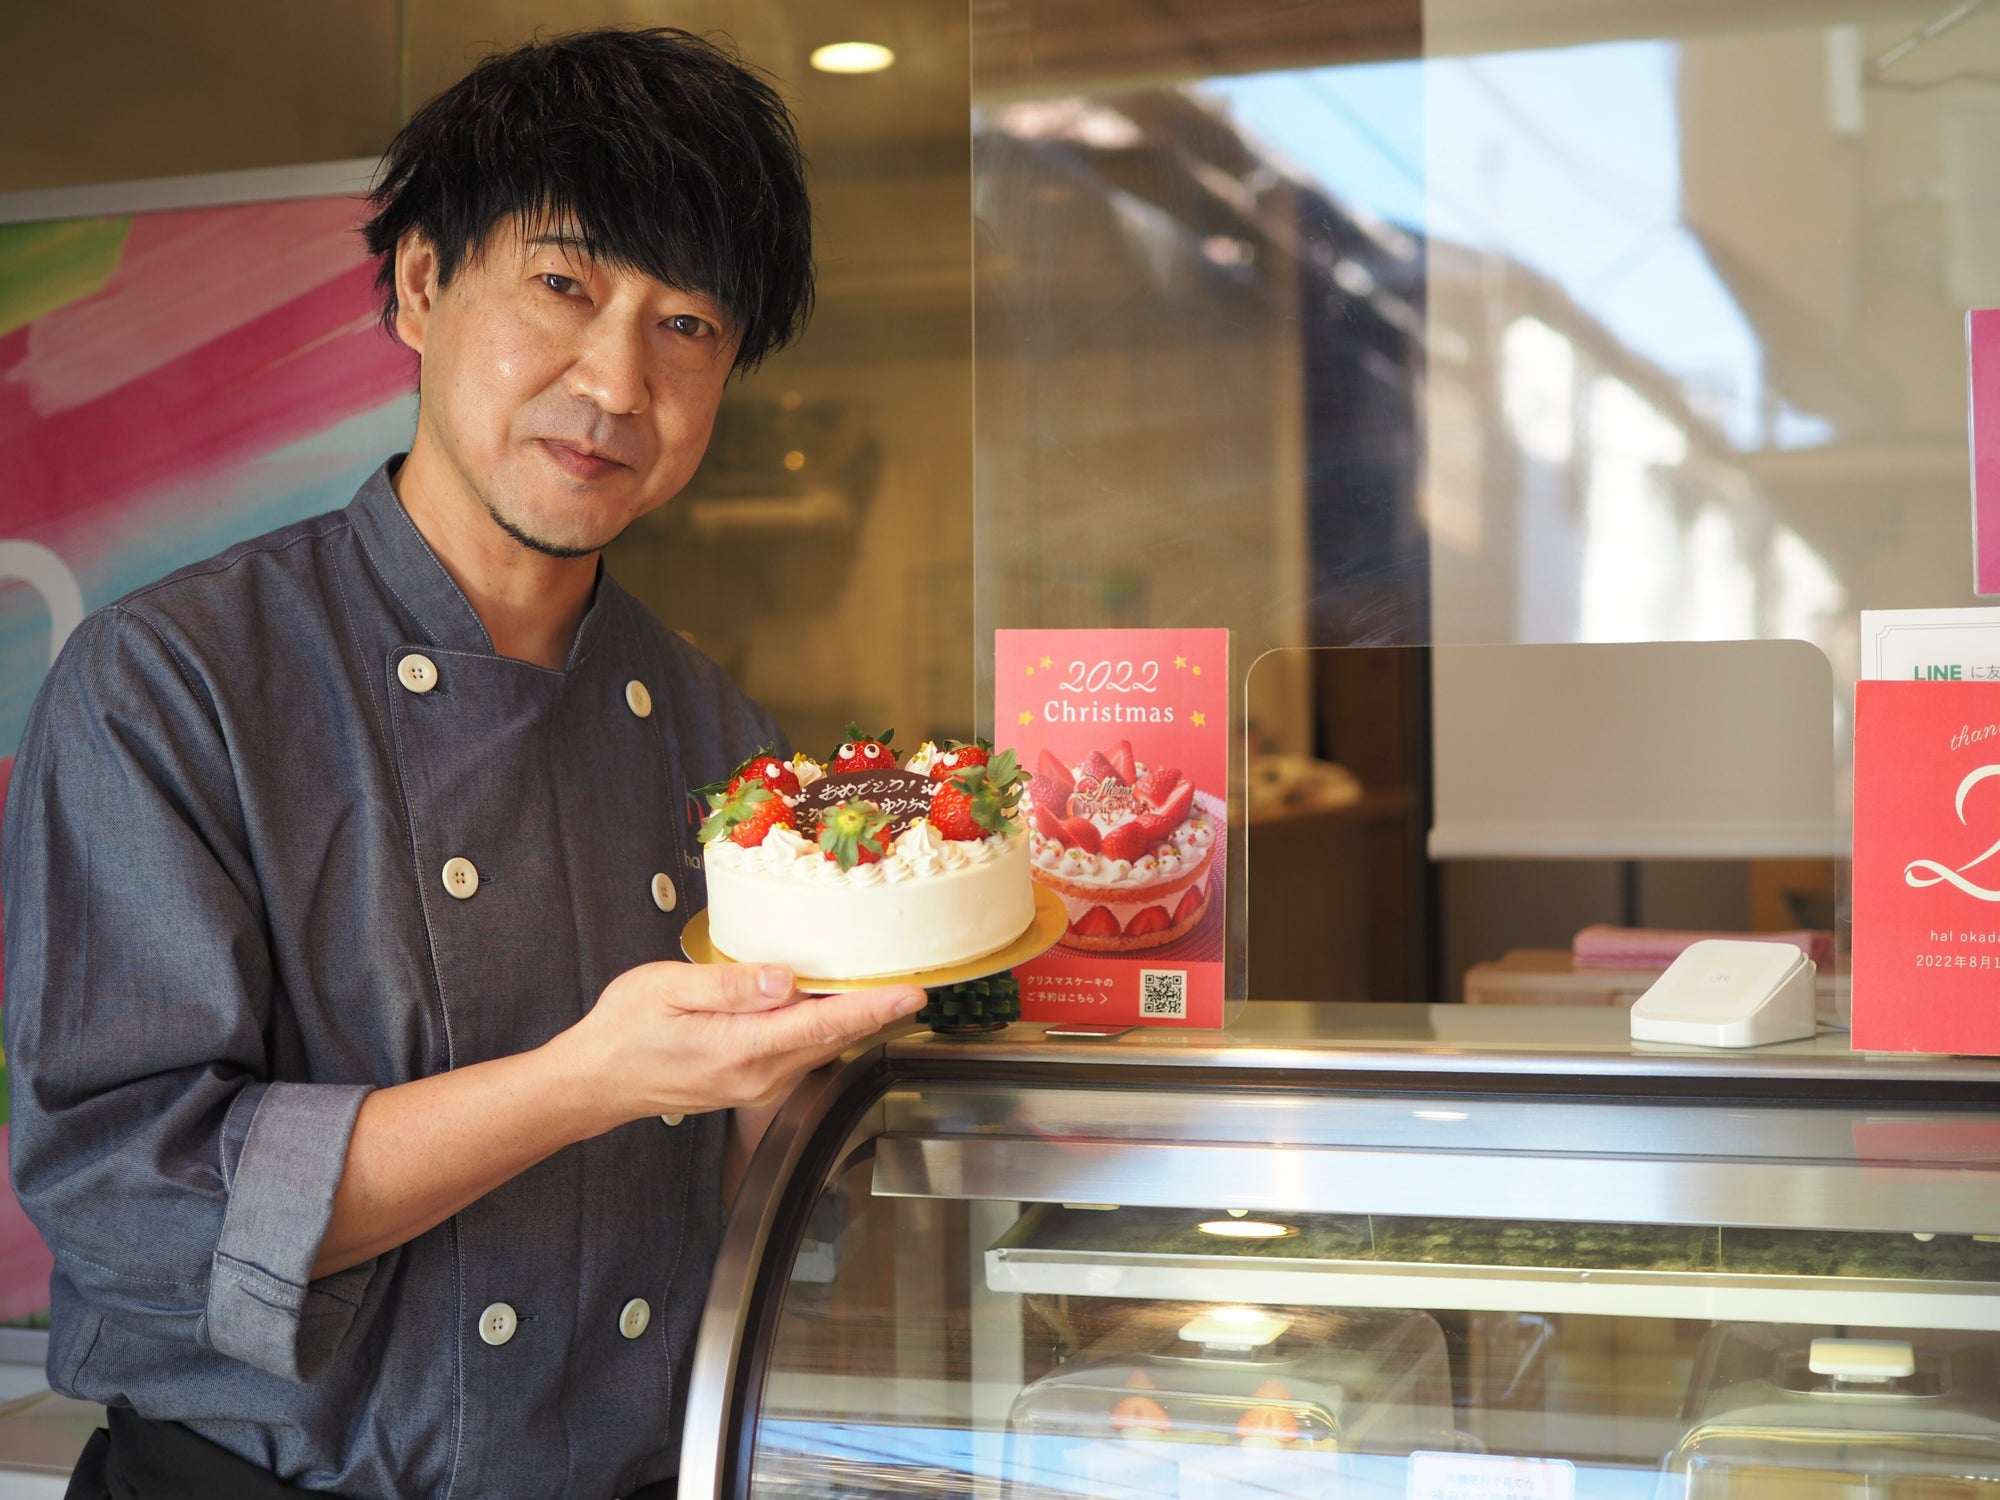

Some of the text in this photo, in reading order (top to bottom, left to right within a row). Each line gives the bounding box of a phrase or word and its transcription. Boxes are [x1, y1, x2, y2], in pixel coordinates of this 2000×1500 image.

[1059, 660, 1159, 693] 2022
[1914, 664, 1962, 681] LINE
[1044, 699, 1174, 722] Christmas
[1950, 723, 2000, 751] than
[1930, 929, 1953, 942] hal
[1027, 975, 1113, 987] クリスマスケーキの
[1026, 991, 1095, 1004] ご予約はこちら
